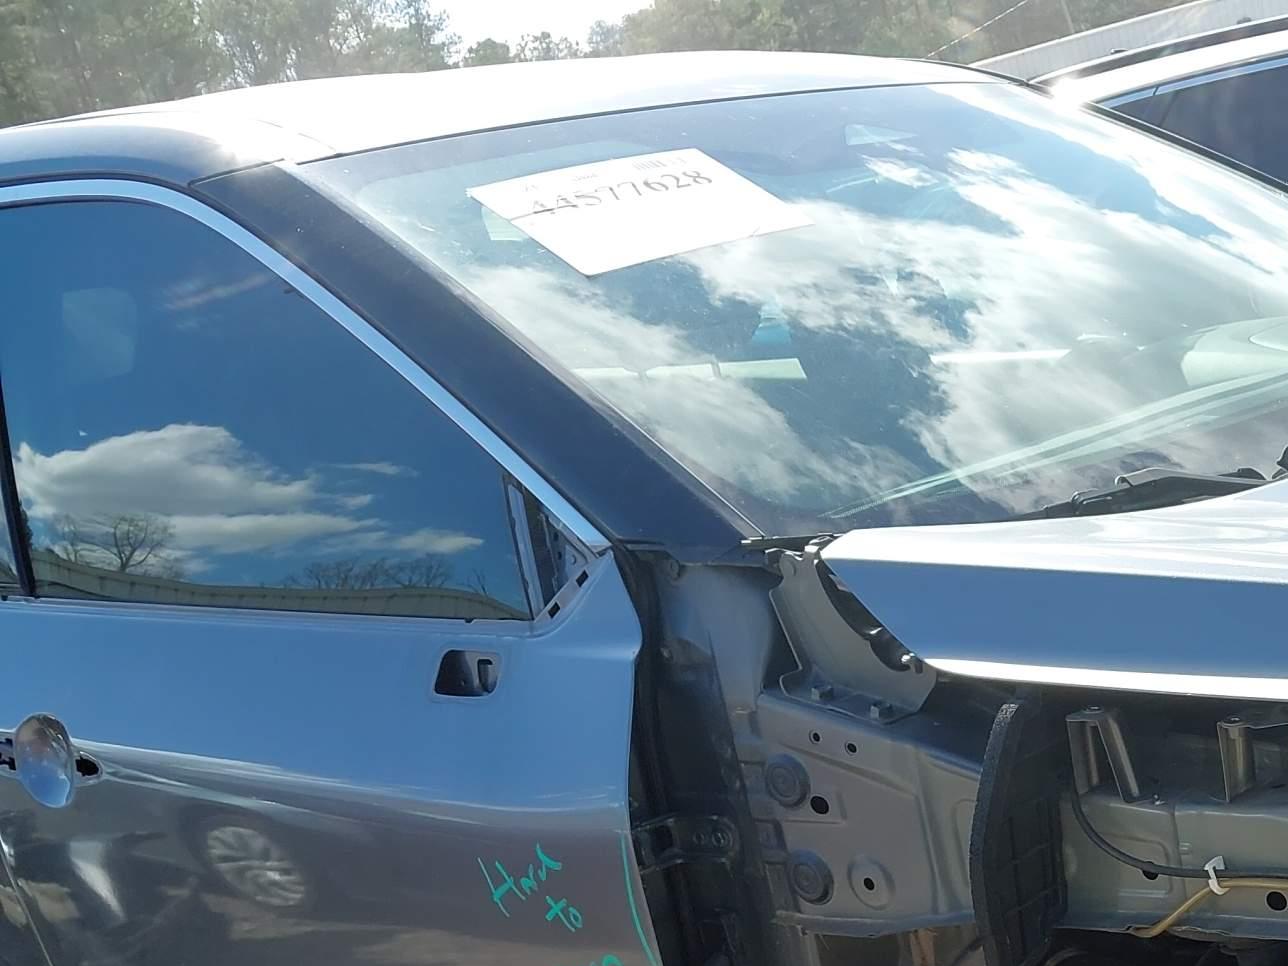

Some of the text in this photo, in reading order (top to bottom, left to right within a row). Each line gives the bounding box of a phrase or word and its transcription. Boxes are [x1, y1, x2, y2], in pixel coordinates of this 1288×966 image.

[533, 170, 712, 214] 44577628
[477, 841, 562, 918] Hard
[545, 895, 583, 932] to
